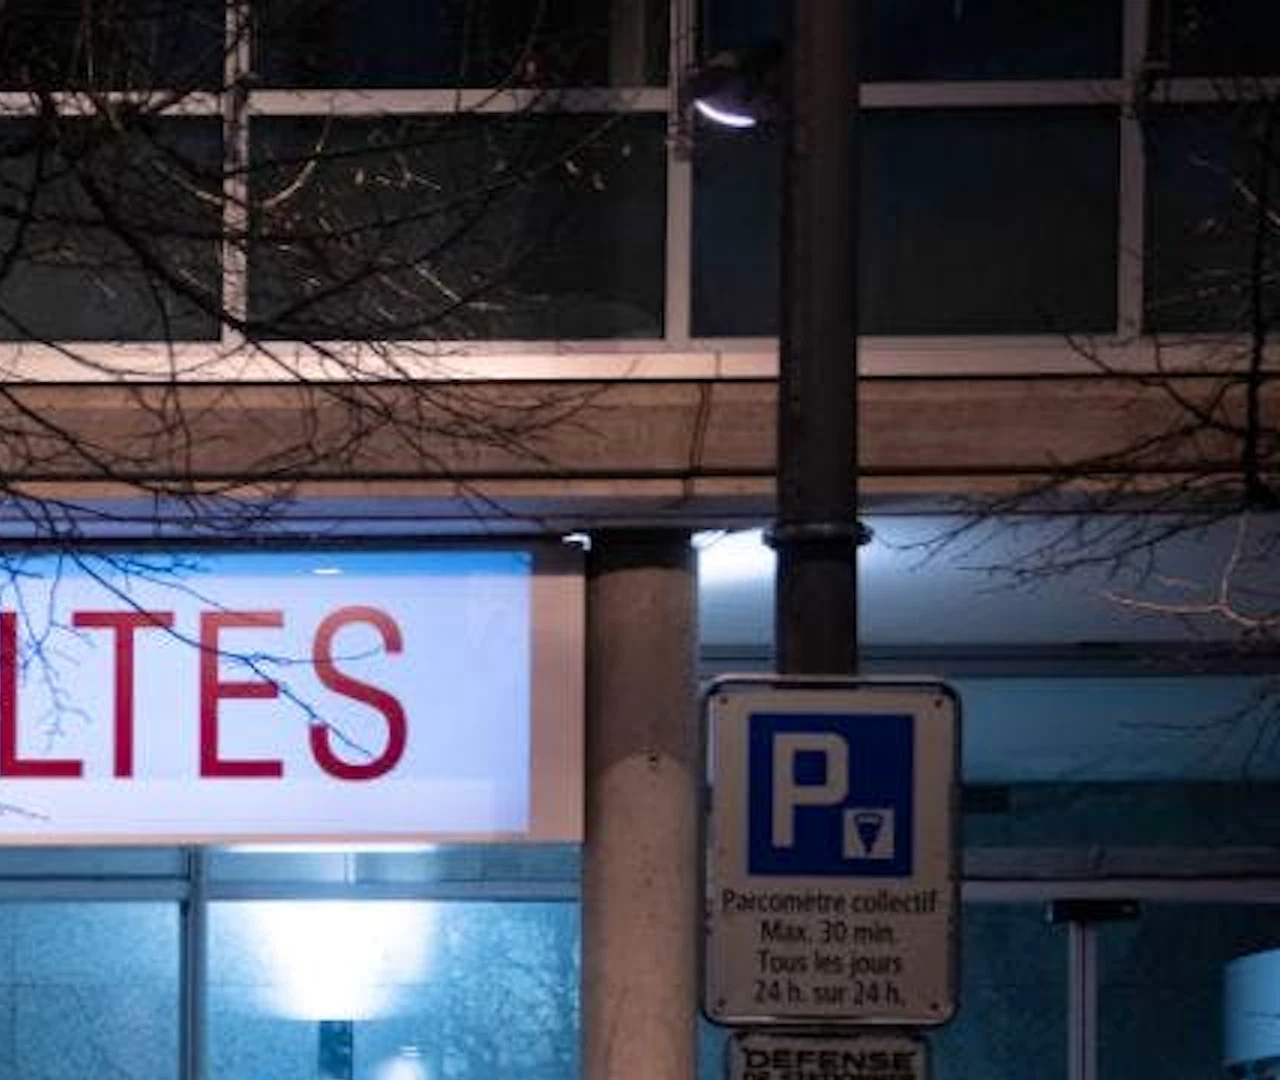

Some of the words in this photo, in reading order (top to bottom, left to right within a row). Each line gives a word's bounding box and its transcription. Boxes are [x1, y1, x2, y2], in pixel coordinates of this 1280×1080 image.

[772, 731, 849, 848] P
[721, 889, 846, 913] Parcomètre
[851, 889, 938, 913] collectif
[760, 919, 812, 943] Max.
[820, 919, 847, 943] 30
[756, 949, 808, 973] Tous
[815, 949, 844, 973] les
[849, 953, 902, 978] jours
[754, 979, 780, 1004] 24
[813, 985, 846, 1004] sur
[853, 979, 878, 1005] 24
